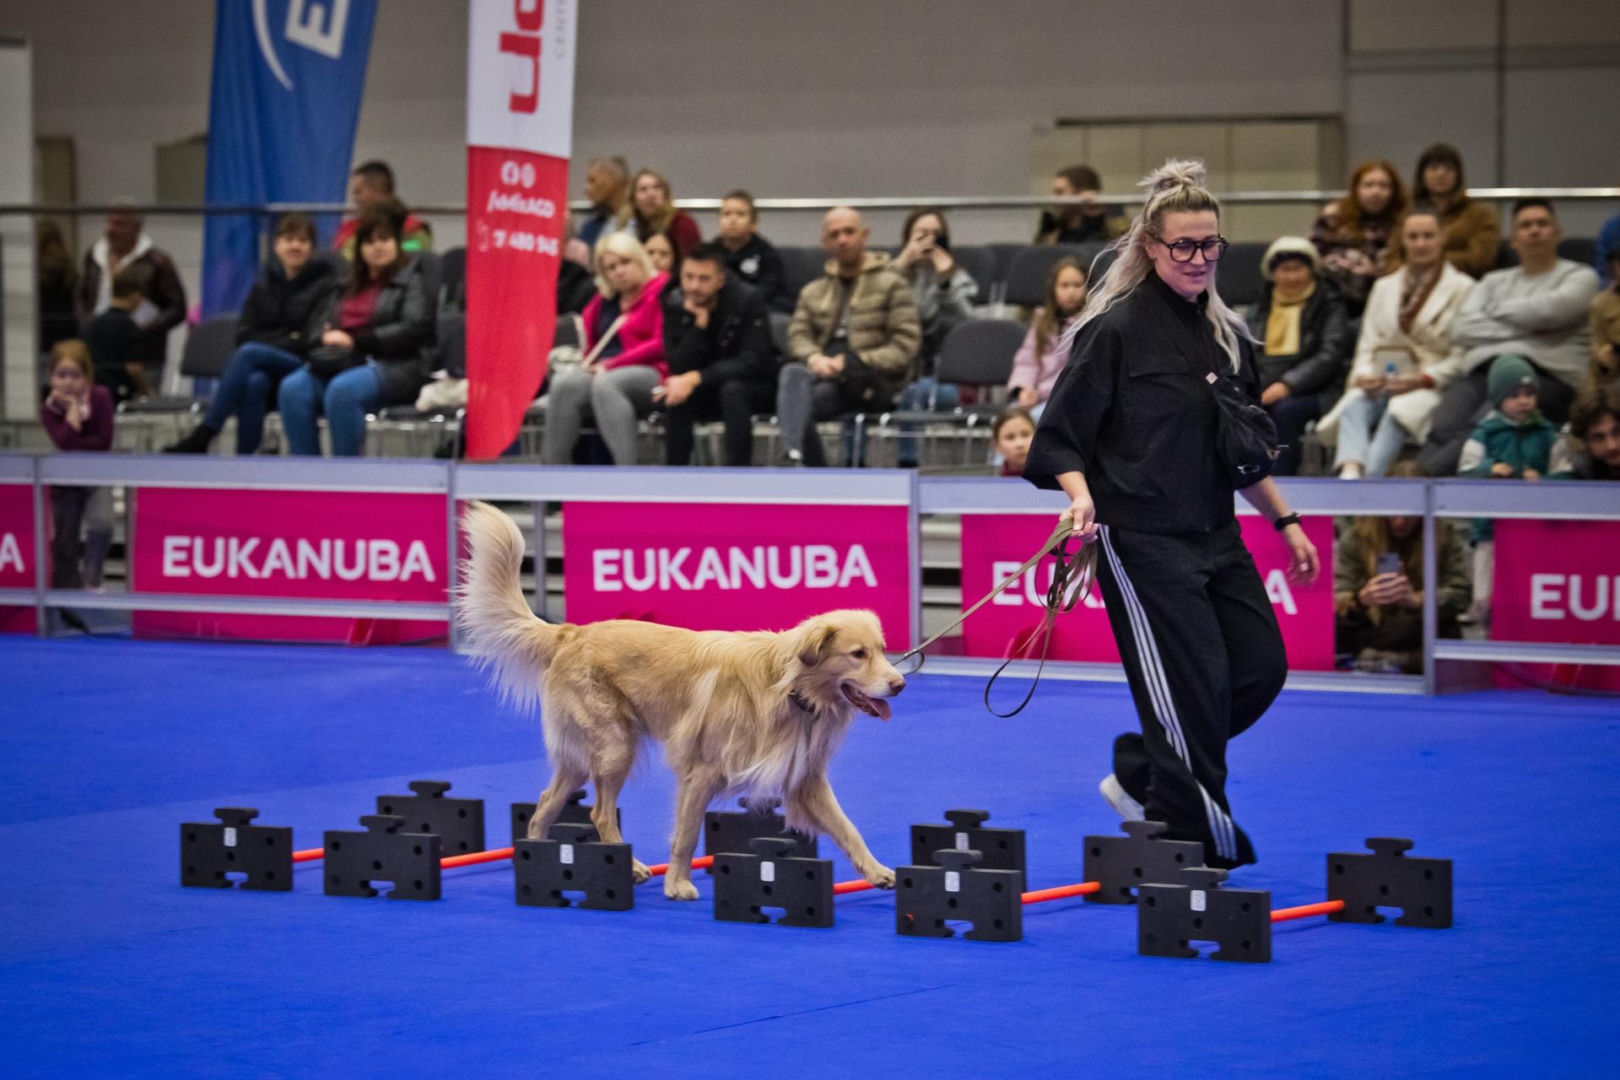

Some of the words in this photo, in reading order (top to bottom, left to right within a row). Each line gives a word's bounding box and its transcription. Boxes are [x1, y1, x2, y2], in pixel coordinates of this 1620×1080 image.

[162, 535, 436, 582] EUKANUBA
[592, 544, 878, 592] EUKANUBA
[1530, 573, 1620, 621] EU
